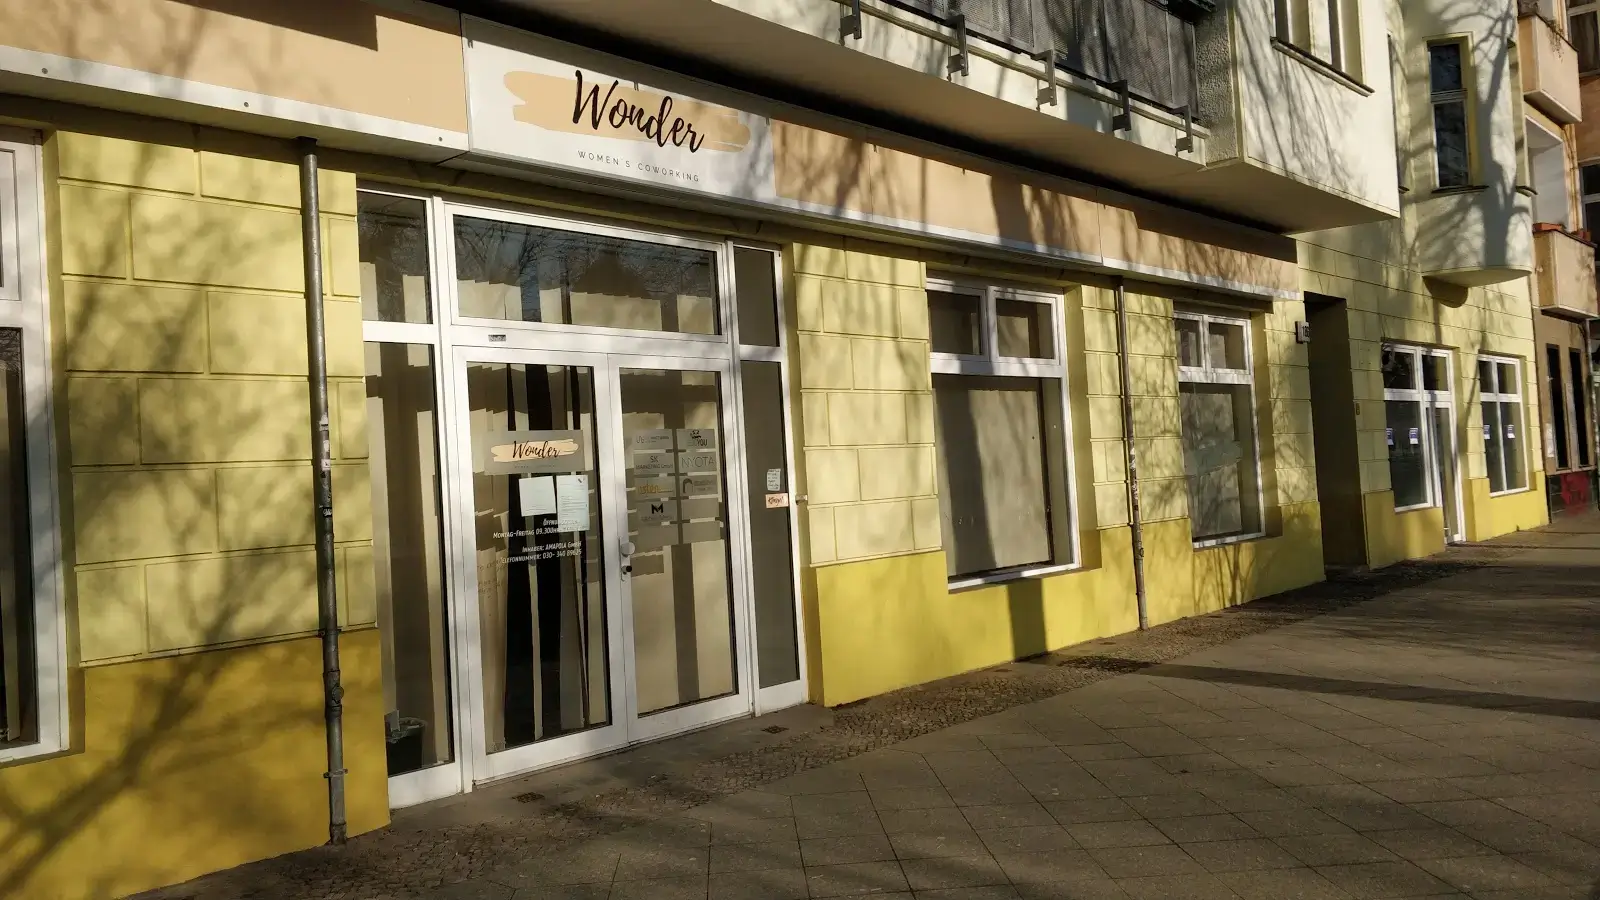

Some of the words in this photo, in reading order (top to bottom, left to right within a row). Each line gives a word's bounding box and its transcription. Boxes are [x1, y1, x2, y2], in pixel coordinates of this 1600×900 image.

[572, 69, 705, 154] Wonder
[637, 161, 700, 182] COWORKING
[512, 440, 561, 459] Wonder
[681, 456, 715, 468] NYOTA
[651, 502, 664, 514] M
